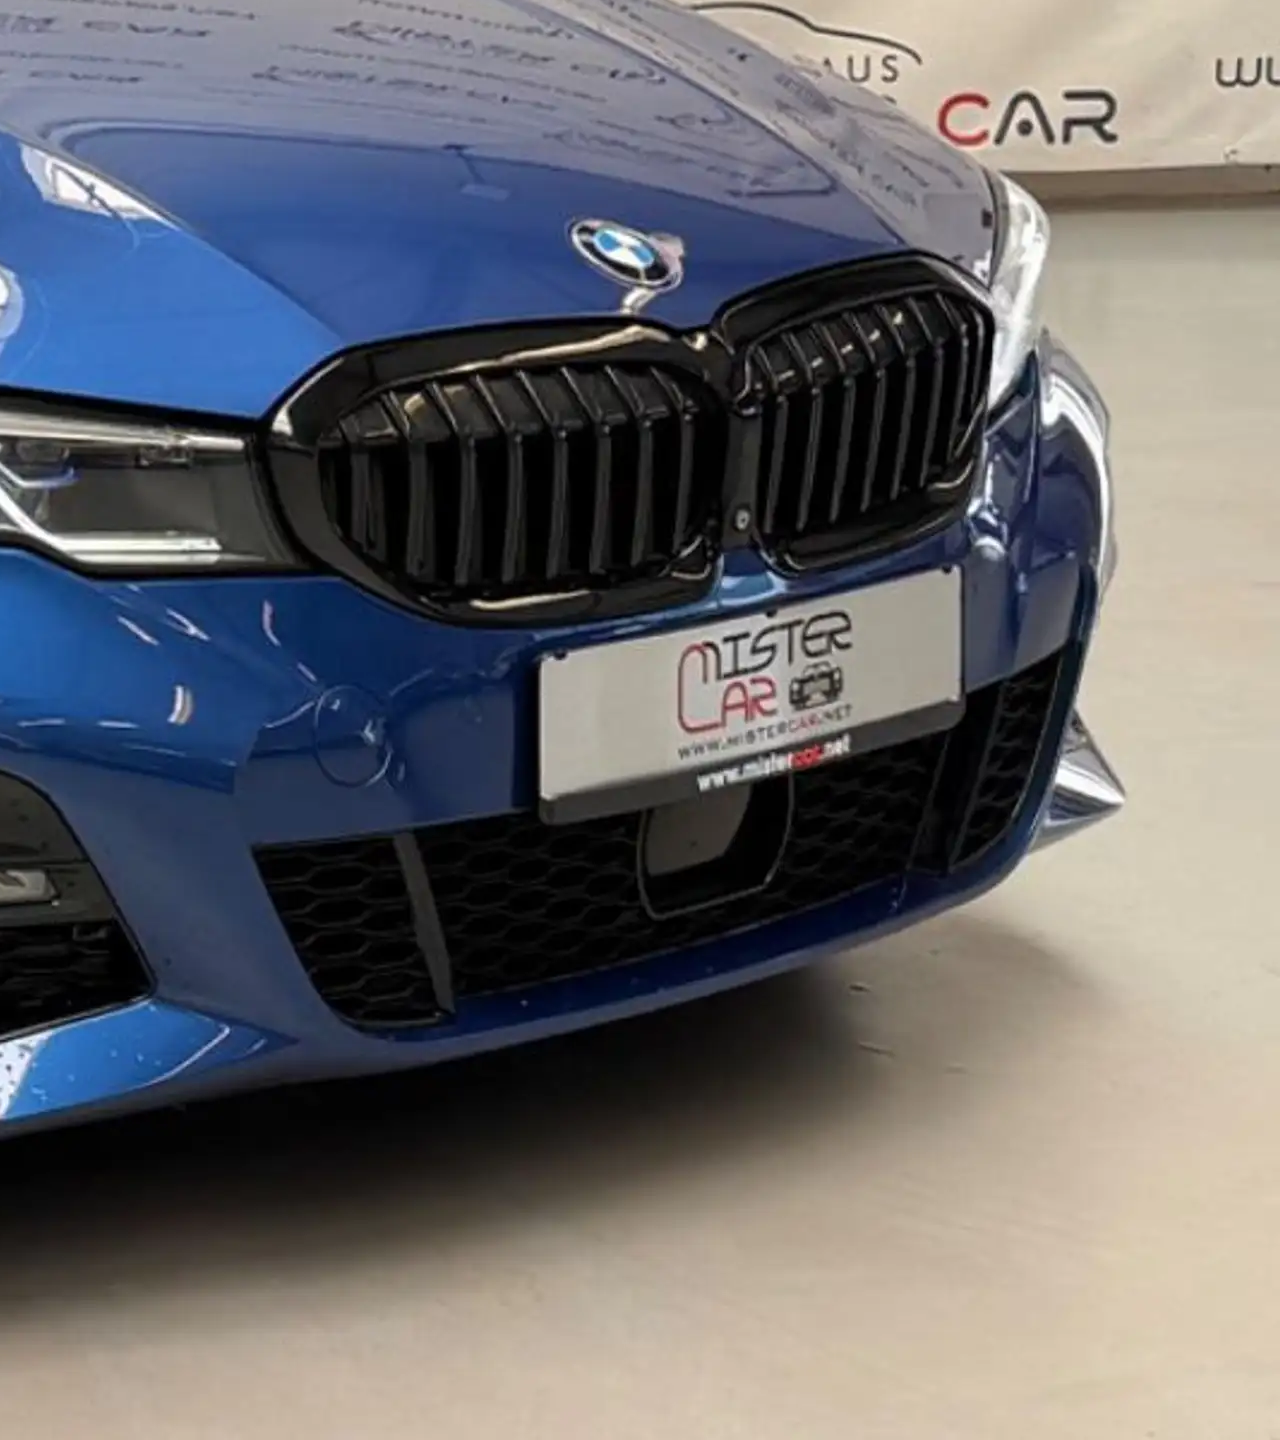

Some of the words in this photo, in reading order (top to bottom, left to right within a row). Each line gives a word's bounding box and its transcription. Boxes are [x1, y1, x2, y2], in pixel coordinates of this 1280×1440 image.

[939, 90, 1118, 145] CAR
[678, 610, 853, 684] MISTER
[697, 733, 851, 792] www.mistercar.net
